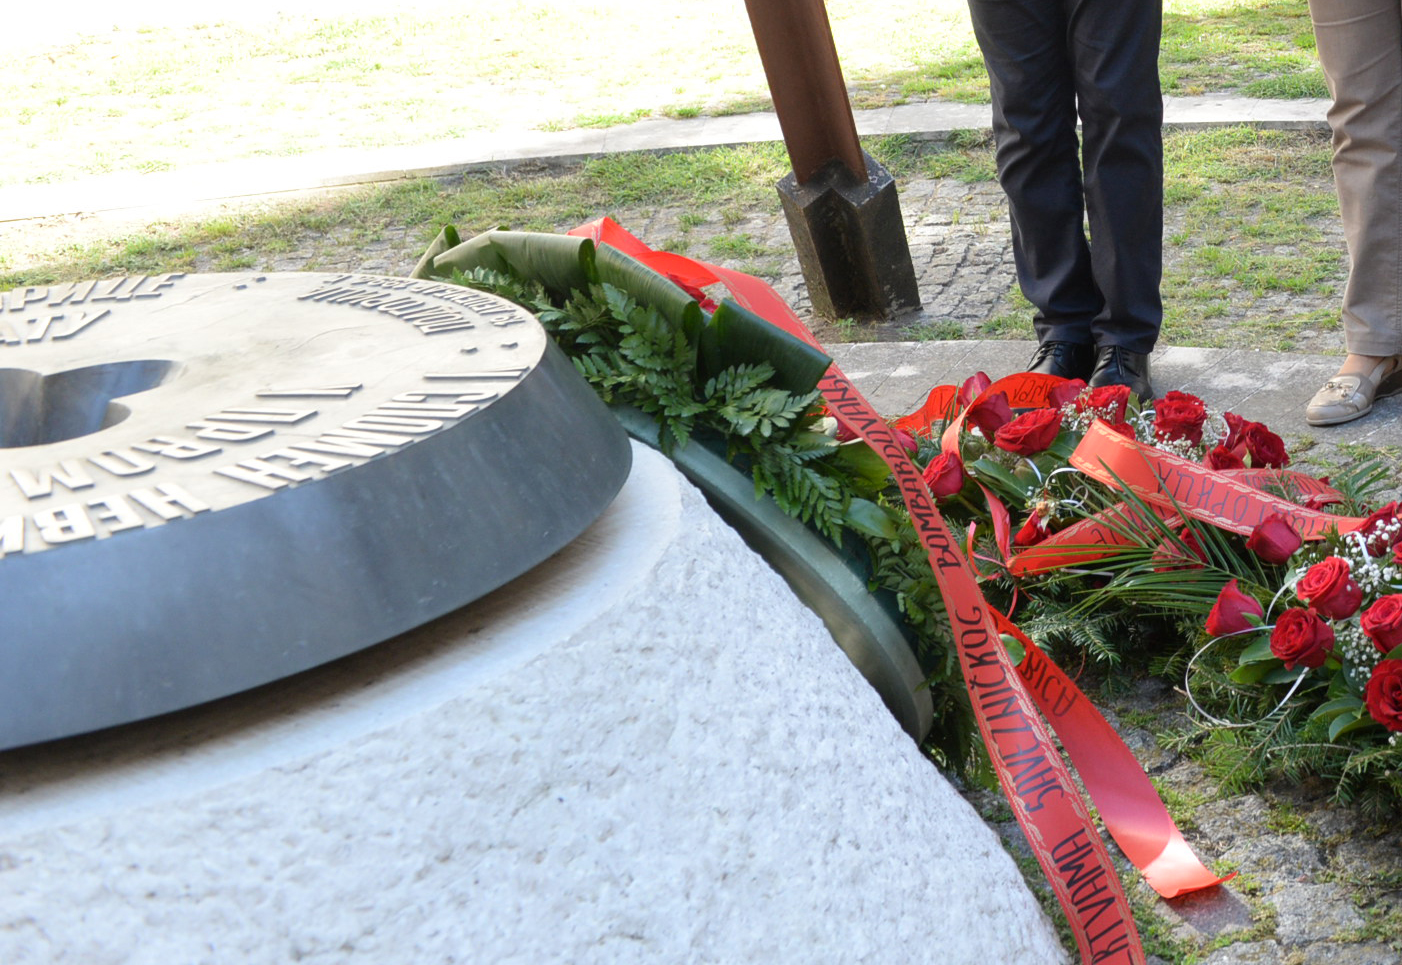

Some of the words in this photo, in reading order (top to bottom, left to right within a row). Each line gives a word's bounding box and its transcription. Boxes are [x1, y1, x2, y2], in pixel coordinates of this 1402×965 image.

[0, 273, 186, 312] РИЦЕ
[9, 410, 319, 500] ПРВОМ
[213, 391, 499, 490] СПОМЕН
[1050, 827, 1136, 965] RTVAMA
